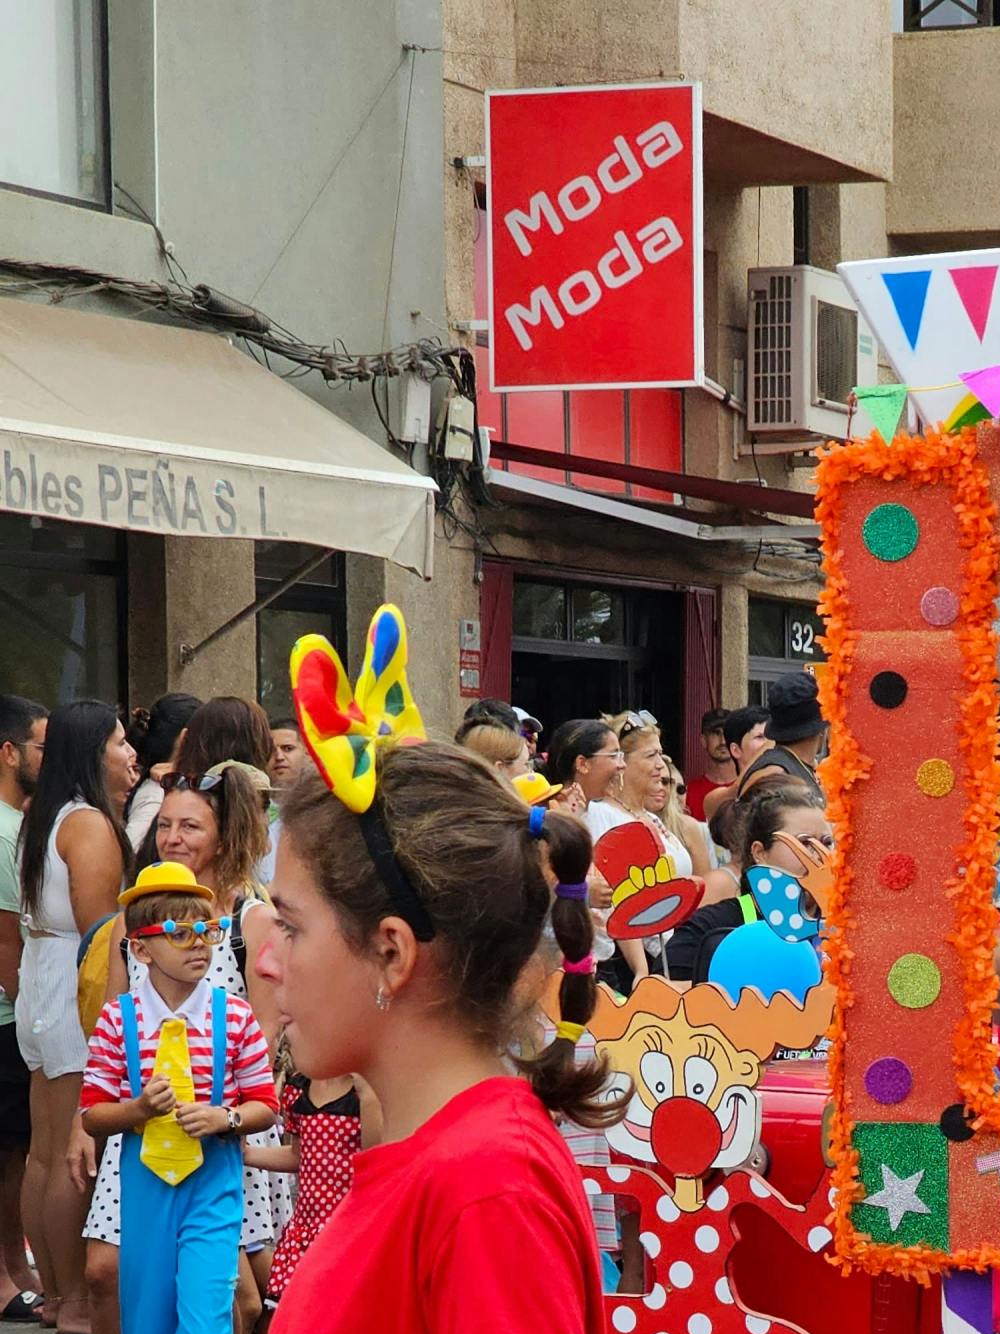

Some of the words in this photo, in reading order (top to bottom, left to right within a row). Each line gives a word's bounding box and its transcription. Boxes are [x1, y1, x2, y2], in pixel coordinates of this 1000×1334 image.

[504, 121, 684, 257] Moda
[504, 216, 684, 351] Moda
[0, 449, 84, 518] bles
[98, 459, 207, 532] PEÑA
[791, 621, 814, 654] 32
